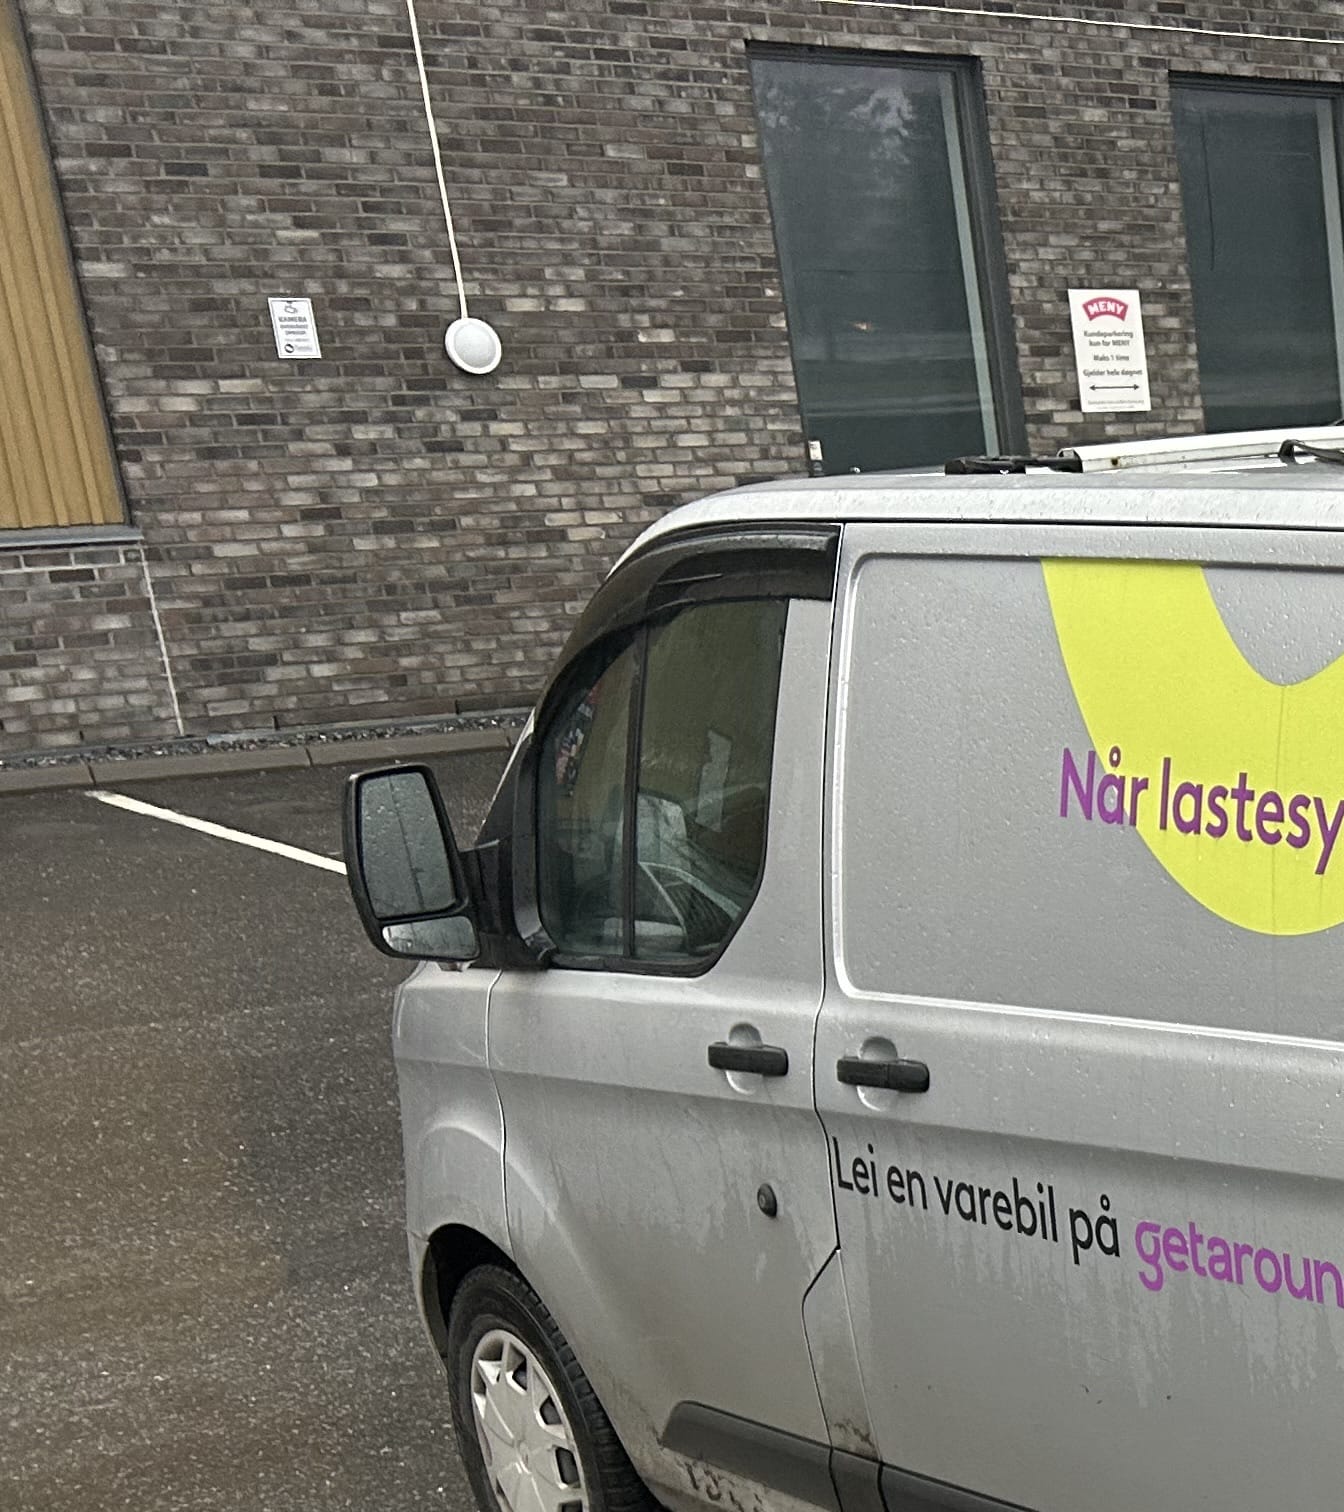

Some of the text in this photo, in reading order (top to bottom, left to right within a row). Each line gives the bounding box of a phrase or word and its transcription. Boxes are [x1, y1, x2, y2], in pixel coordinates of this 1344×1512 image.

[1087, 300, 1125, 315] MENY
[1059, 745, 1149, 829] Når
[832, 1136, 879, 1198] Lei
[888, 1165, 929, 1208] en
[933, 1176, 1058, 1243] varebil
[1069, 1193, 1122, 1266] på
